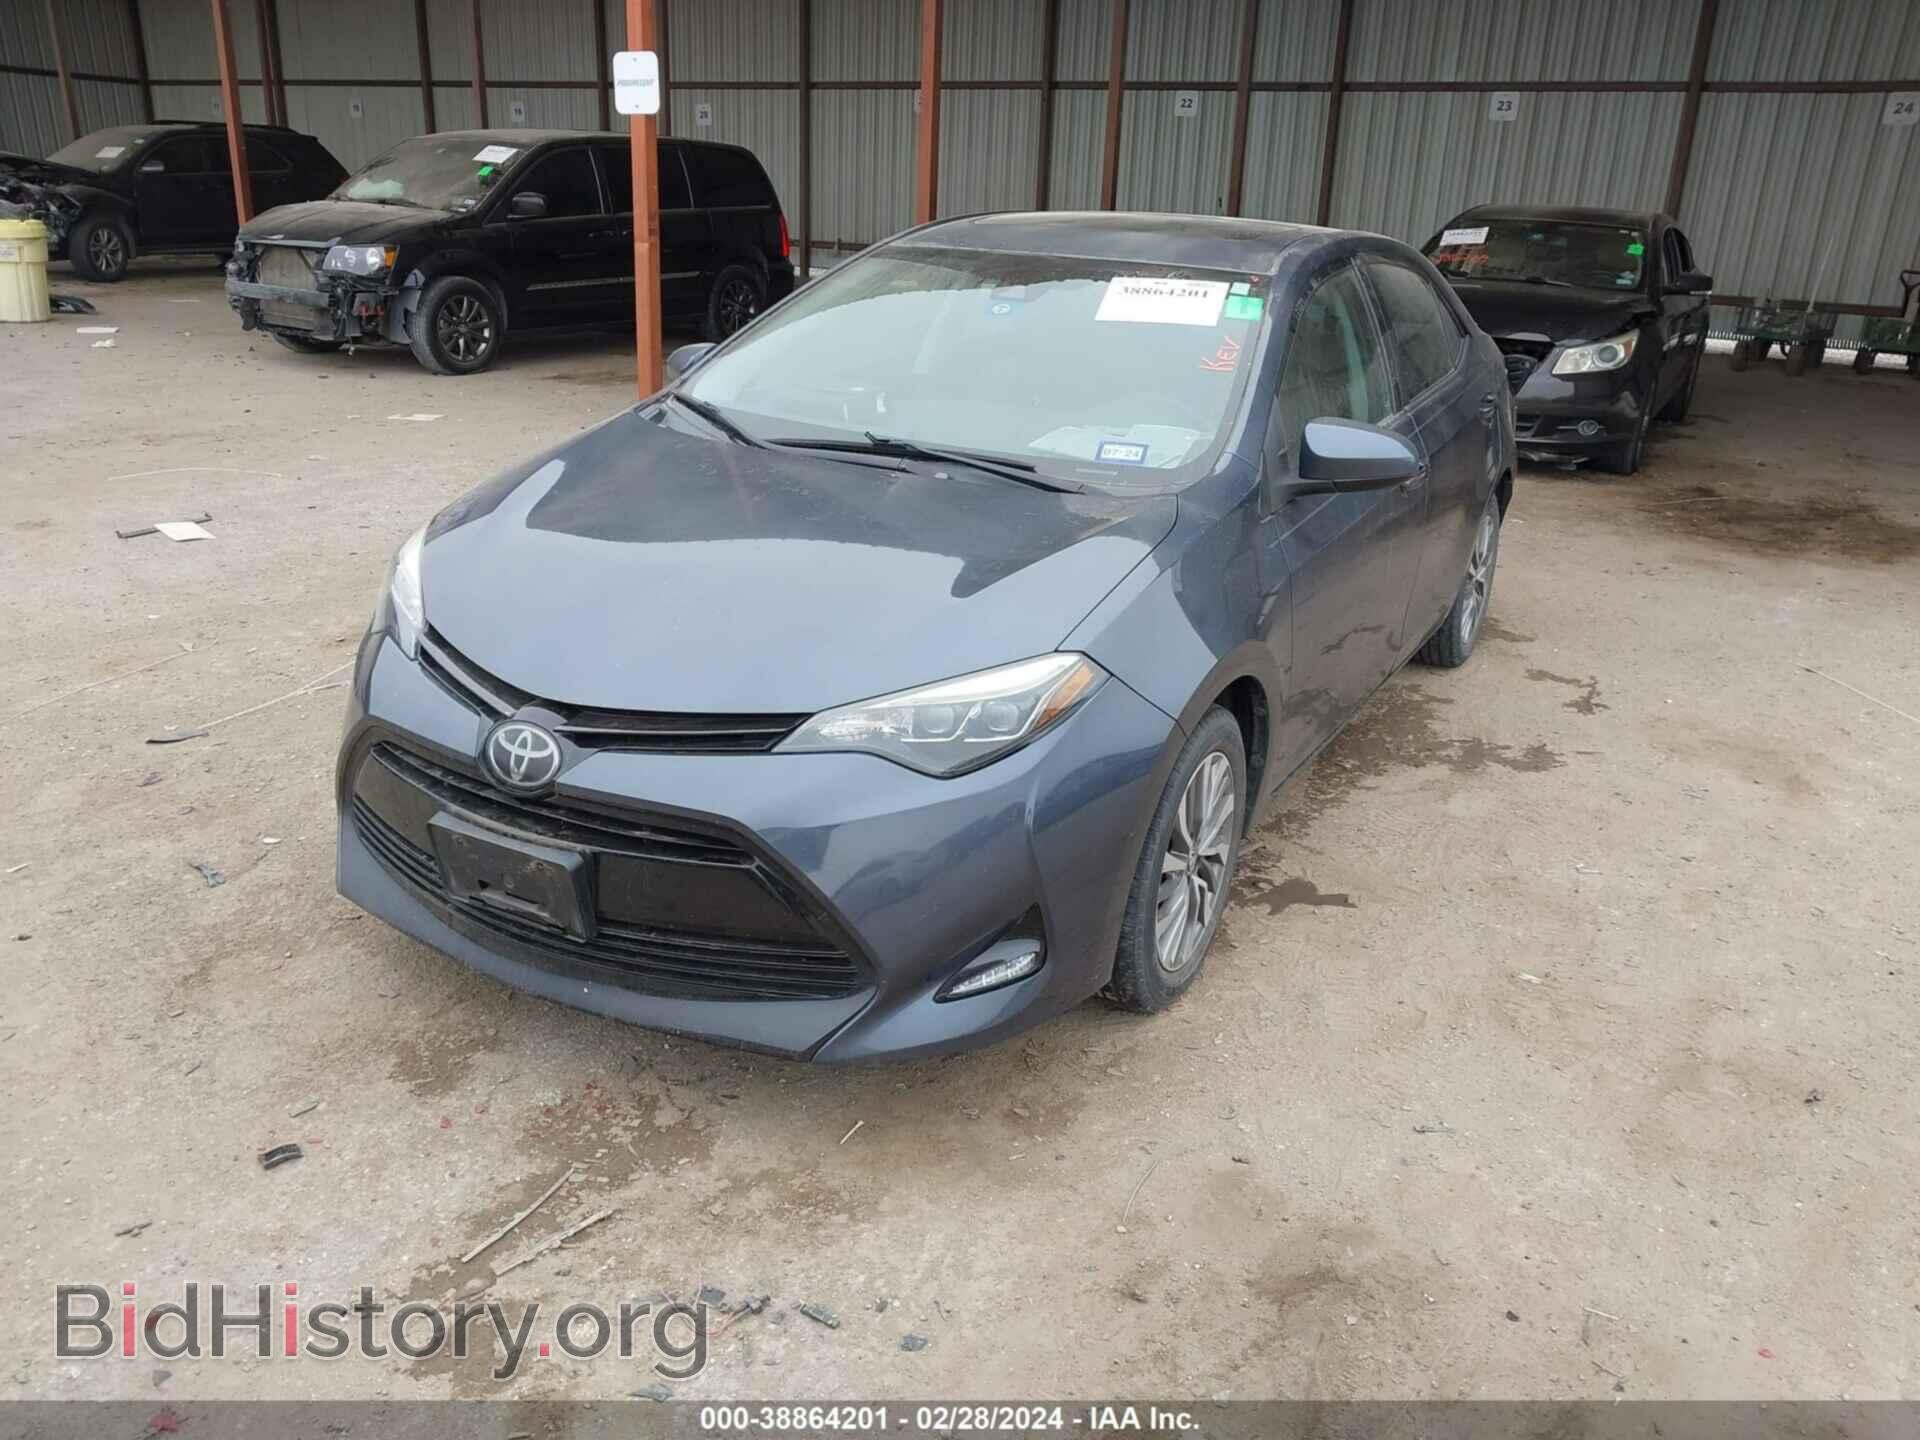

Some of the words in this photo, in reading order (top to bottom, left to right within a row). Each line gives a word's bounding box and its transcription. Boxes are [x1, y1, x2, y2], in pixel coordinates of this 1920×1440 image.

[1180, 98, 1193, 108] 22
[1496, 100, 1513, 112] 23
[1892, 101, 1915, 115] 24
